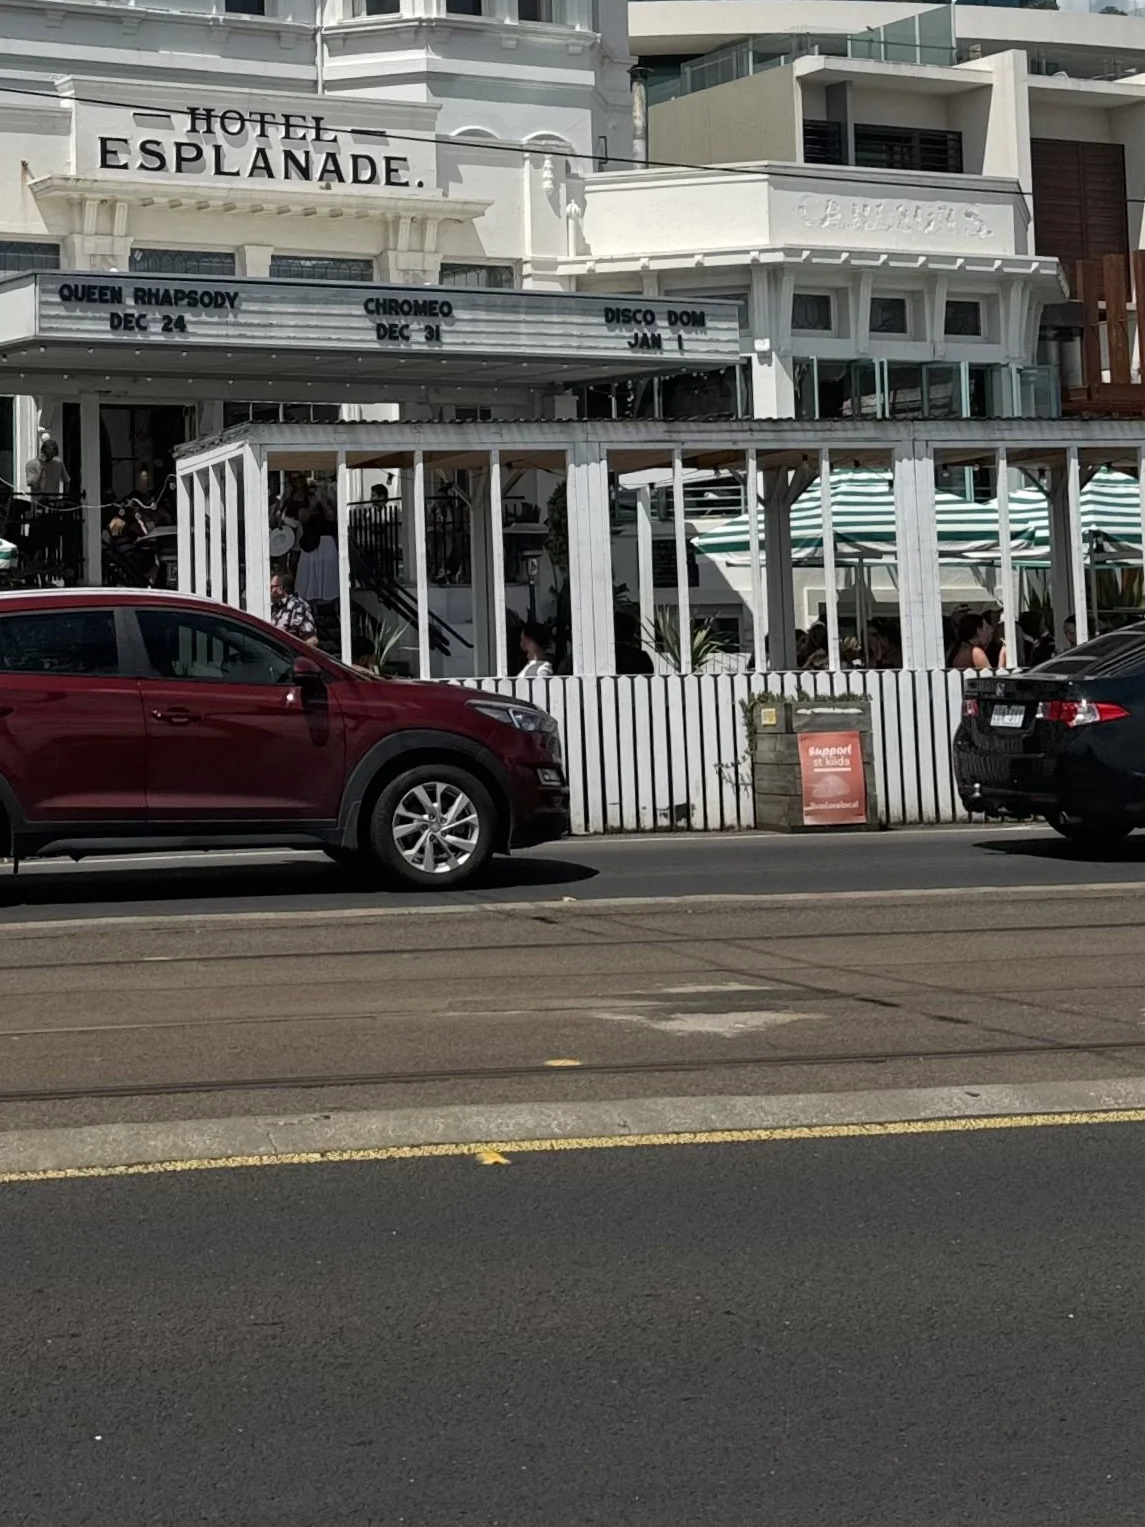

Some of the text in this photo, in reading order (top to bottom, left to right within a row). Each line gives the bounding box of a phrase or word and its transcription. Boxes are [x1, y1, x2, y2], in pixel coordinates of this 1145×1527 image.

[186, 107, 338, 144] HOTEL
[98, 136, 424, 188] ESPLANADE.
[58, 284, 239, 309] QUEEN RHAPSODY
[363, 298, 453, 317] CHROMEO
[604, 307, 706, 327] DISCO DOM
[110, 312, 187, 332] DEC 24
[376, 323, 441, 342] DEC 31
[627, 332, 684, 350] JAN 1
